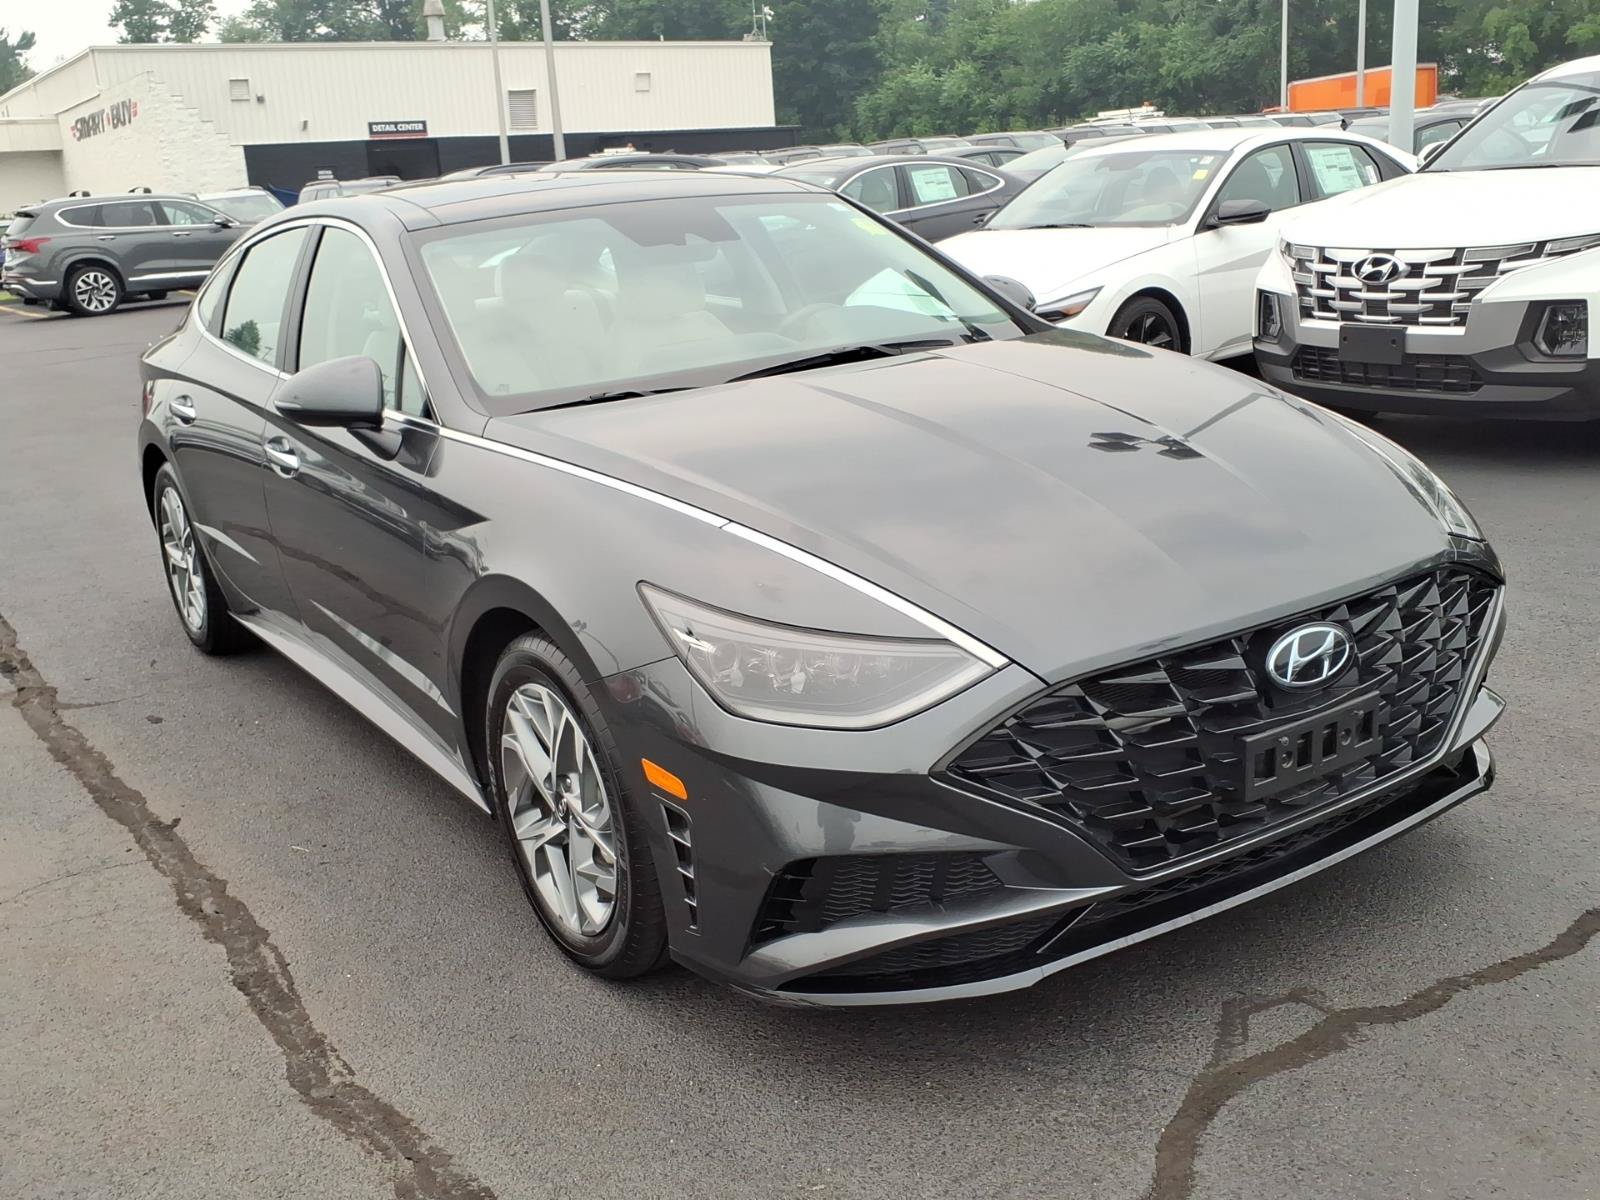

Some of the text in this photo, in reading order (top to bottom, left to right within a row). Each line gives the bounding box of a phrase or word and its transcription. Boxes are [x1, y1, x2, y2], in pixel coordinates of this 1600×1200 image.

[74, 98, 132, 142] SMART BUY
[371, 123, 424, 132] DETAIL CENTER
